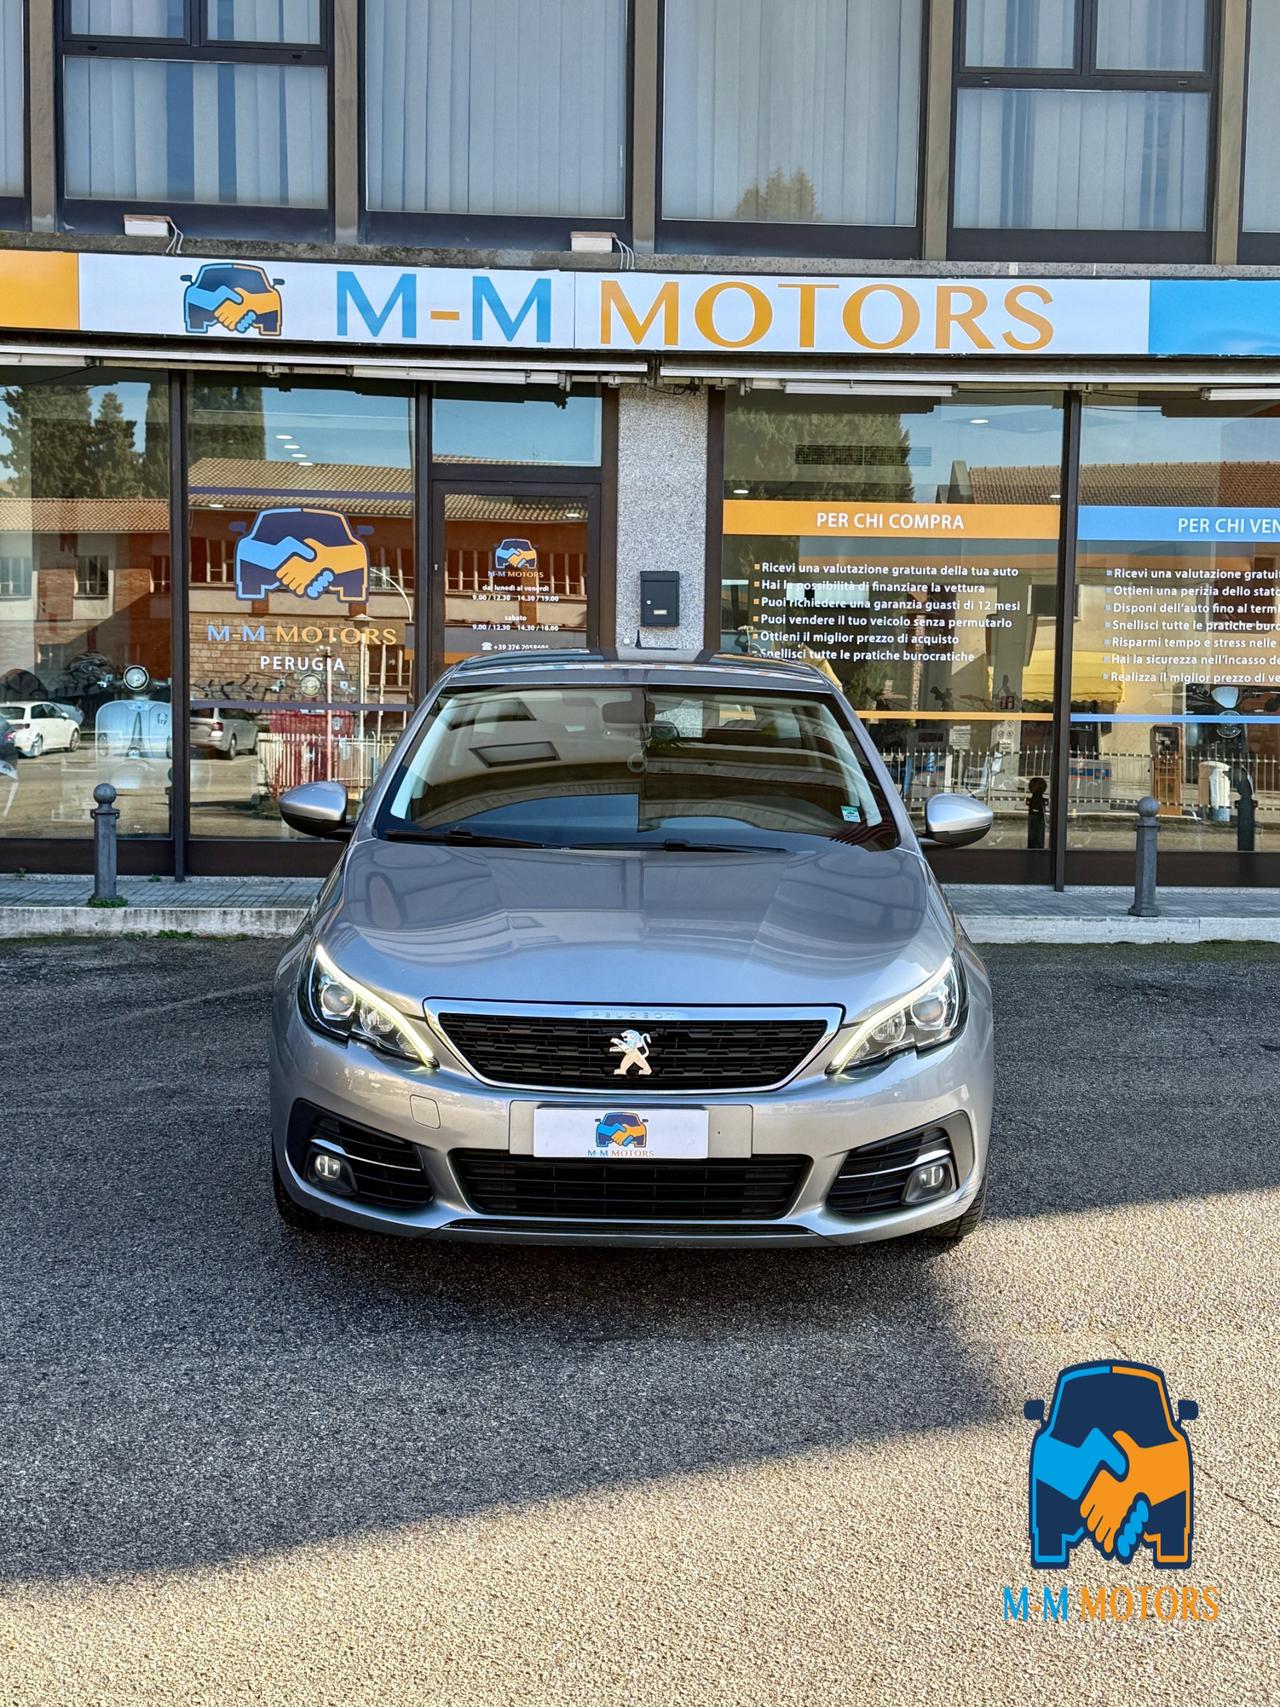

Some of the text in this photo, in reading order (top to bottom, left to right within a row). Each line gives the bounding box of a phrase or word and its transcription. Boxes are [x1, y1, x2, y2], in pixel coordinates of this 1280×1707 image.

[337, 271, 1054, 350] M-M MOTORS
[817, 513, 964, 529] PER CHI COMPRA
[1178, 518, 1210, 533] PER
[1215, 518, 1244, 533] CHI
[488, 570, 506, 578] M-M
[762, 563, 1019, 576] Ricevi una valutazione gratuita della tua auto
[1114, 568, 1147, 578] Ricevi
[1151, 571, 1172, 579] una
[1175, 569, 1241, 579] valutazione
[762, 580, 779, 590] Hai
[798, 580, 855, 592] possibilità
[857, 581, 869, 591] di
[872, 581, 928, 592] finanziare
[931, 583, 941, 593] la
[944, 584, 985, 593] vettura
[1114, 586, 1153, 596] Ottieni
[1156, 588, 1177, 596] una
[1181, 586, 1219, 597] perizia
[1222, 586, 1251, 596] dello
[761, 597, 786, 607] Puoi
[789, 597, 847, 608] richiedere
[874, 600, 922, 611] garanzia
[925, 601, 960, 611] guasti
[963, 601, 974, 610] di
[978, 601, 991, 610] 12
[994, 601, 1020, 611] mesi
[1113, 603, 1156, 615] Disponi
[1213, 603, 1234, 613] fino
[1237, 604, 1247, 613] al
[504, 613, 527, 621] sabato
[761, 614, 1012, 629] Puoi vendere il tuo veicolo senza permutarlo
[1112, 620, 1159, 630] Snellisci
[1162, 621, 1189, 630] tutte
[1193, 621, 1203, 630] le
[1206, 620, 1253, 632] pratiche
[207, 625, 397, 645] M-M MOTORS
[760, 632, 959, 645] Ottieni il miglior prezzo di acquisto
[1112, 637, 1161, 649] Risparmi
[1165, 639, 1200, 649] tempo
[1214, 639, 1246, 648] stress
[1249, 638, 1277, 648] nelle
[760, 649, 975, 662] Snellisci tutte le pratiche burocratiche
[1111, 654, 1130, 664] Hai
[1133, 654, 1143, 664] la
[1146, 655, 1197, 665] sicurezza
[260, 656, 345, 672] PERUGIA
[1111, 672, 1156, 682] Realizza
[1160, 672, 1166, 682] il
[1170, 672, 1210, 684] miglior
[1213, 675, 1251, 685] prezzo
[1254, 673, 1264, 682] di
[592, 1011, 675, 1019] PEUGEOT
[588, 1149, 655, 1157] M-M MOTORS
